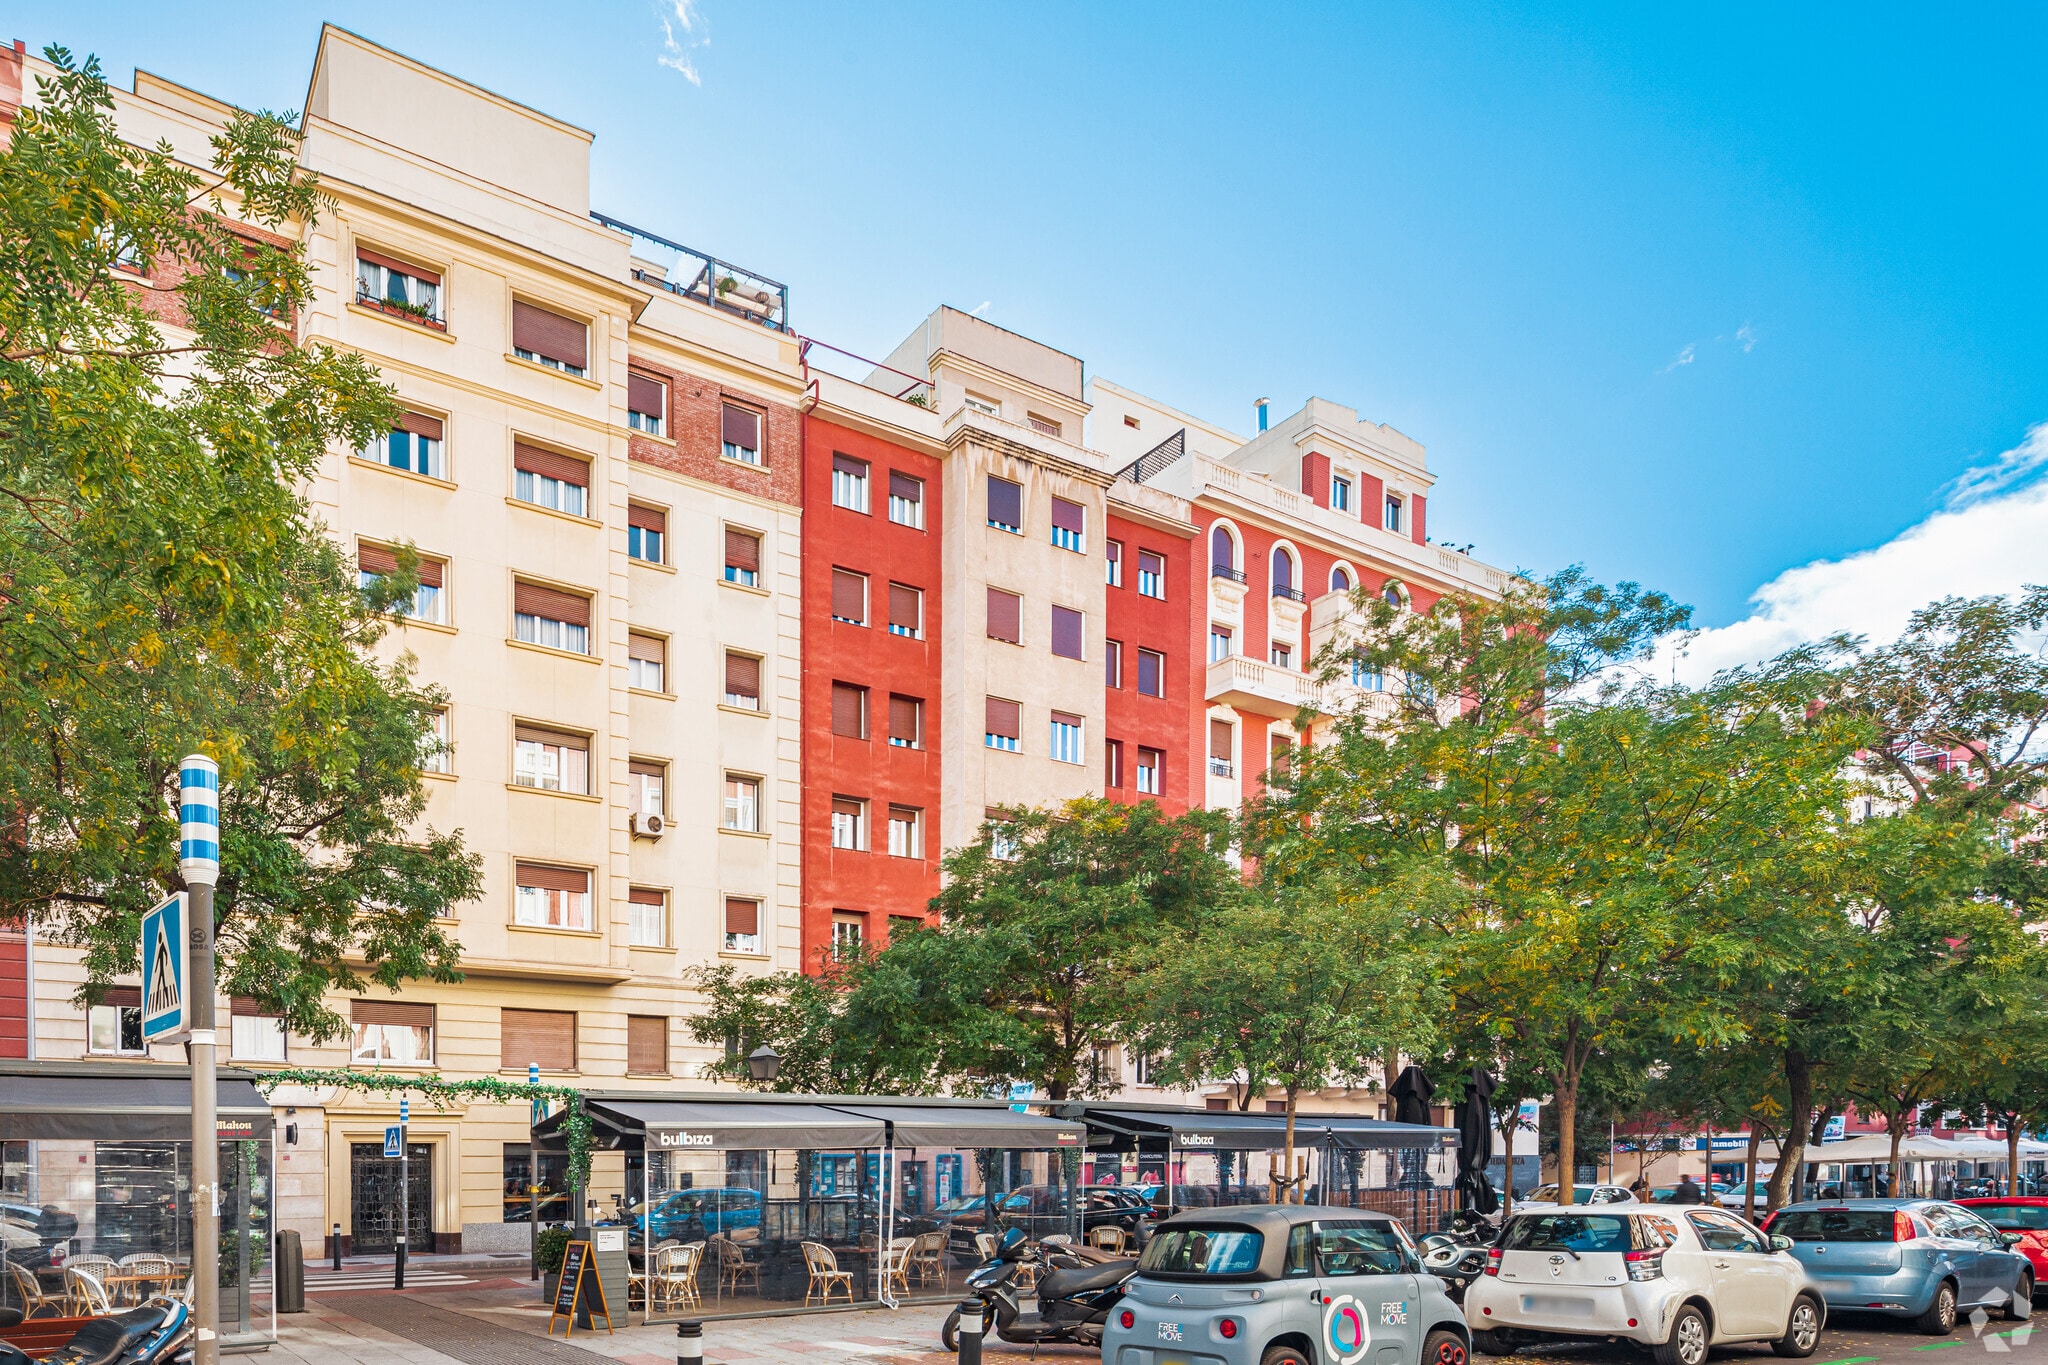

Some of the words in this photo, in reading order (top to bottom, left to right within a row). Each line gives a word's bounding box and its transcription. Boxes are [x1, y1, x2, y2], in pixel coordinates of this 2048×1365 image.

[216, 1120, 252, 1130] Mahou
[1181, 1133, 1214, 1145] bulbiza
[1711, 1140, 1748, 1148] Inmobili
[1380, 1313, 1407, 1326] MOVE
[1158, 1331, 1183, 1342] MOVE
